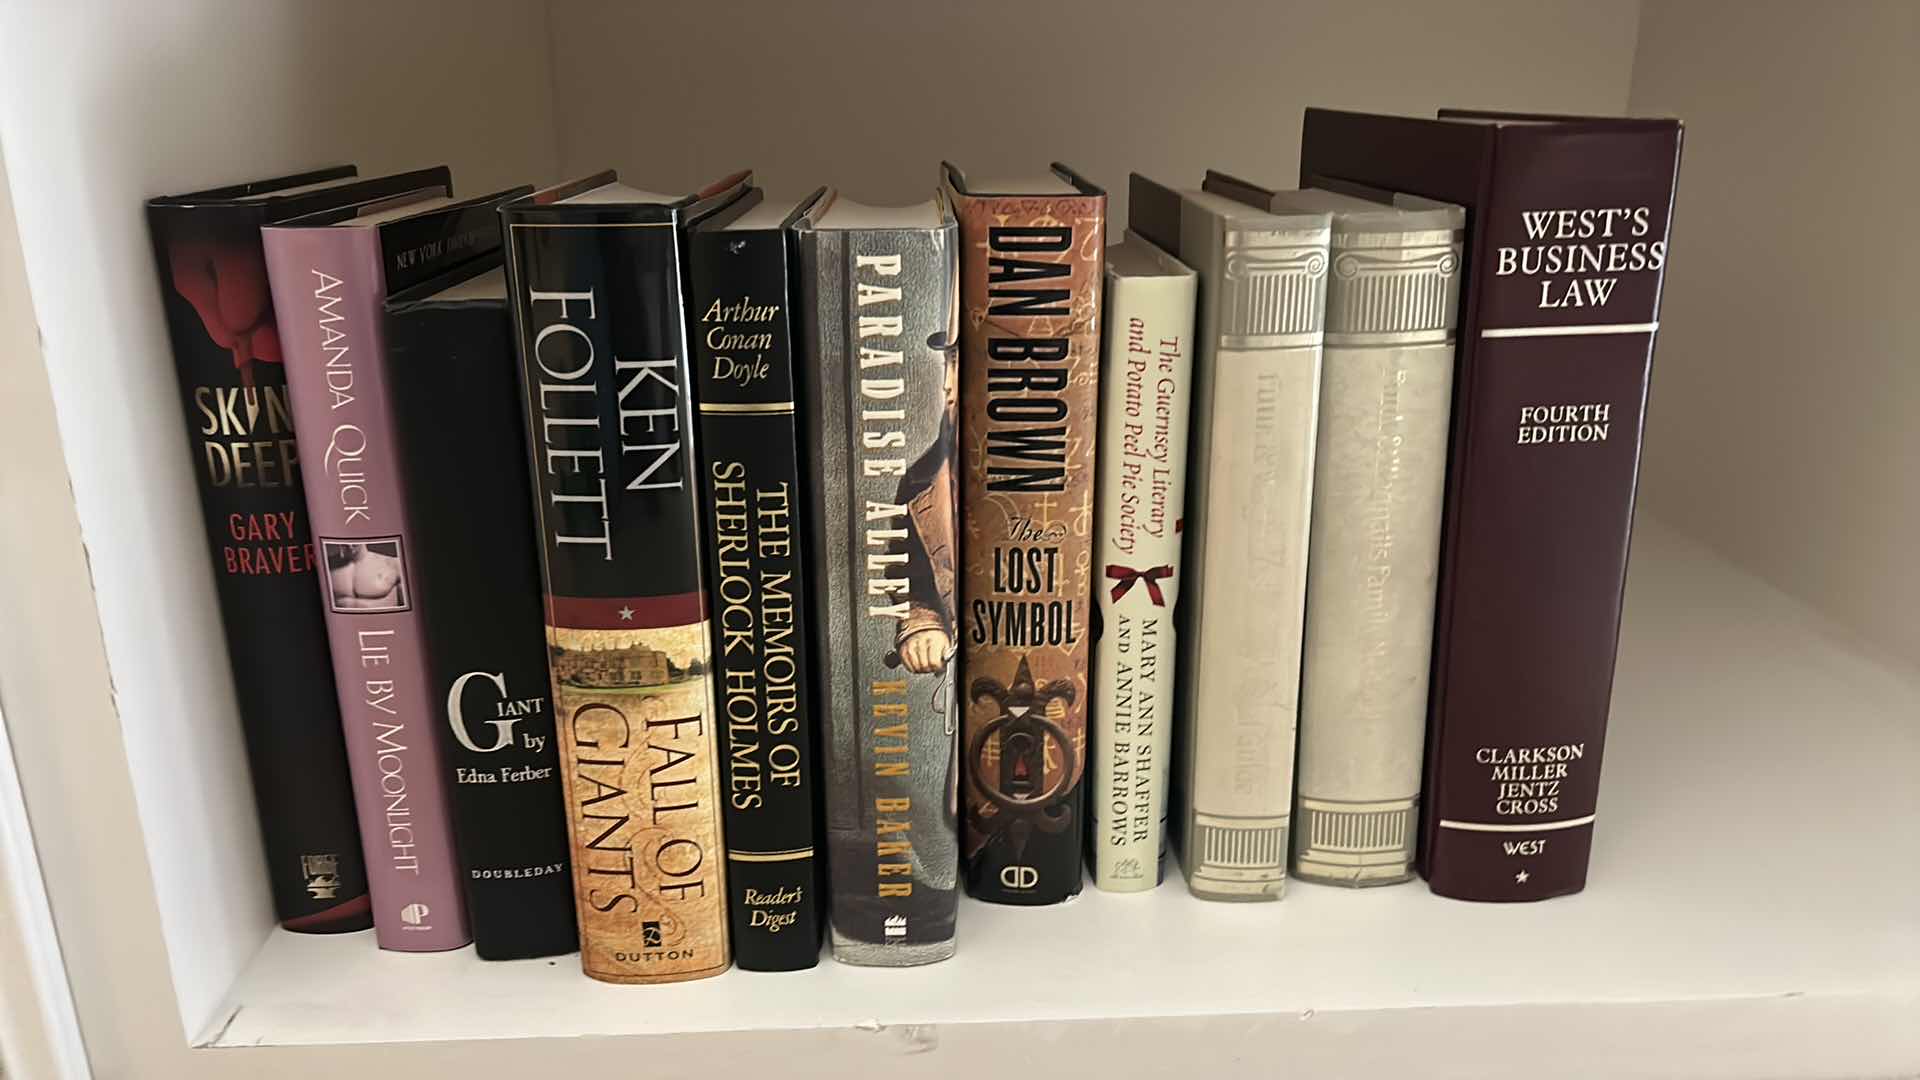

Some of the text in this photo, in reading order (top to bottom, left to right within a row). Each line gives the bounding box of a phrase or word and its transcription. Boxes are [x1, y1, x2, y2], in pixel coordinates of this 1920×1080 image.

[1520, 207, 1649, 240] WEST'S
[1496, 241, 1664, 276] BUSINESS
[702, 297, 779, 323] Arthur
[1539, 278, 1617, 308] LAW
[706, 326, 772, 350] Conan
[712, 355, 769, 387] Doyle
[987, 226, 1072, 493] DAN BROWN
[195, 386, 291, 436] SKIN
[312, 269, 370, 525] AMANDA QUICK
[530, 287, 612, 560] FOLLETT
[615, 355, 684, 491] KEN
[1520, 404, 1609, 425] FOURTH
[857, 254, 910, 619] PARADISE ALLEY
[1112, 318, 1151, 555] and Potato Peel Pie Society
[1141, 336, 1181, 539] The Guernsey Literary
[1517, 423, 1609, 444] EDITION
[230, 511, 294, 541] GARY
[1009, 514, 1062, 541] The
[993, 546, 1059, 593] LOST
[712, 461, 762, 810] SHERLOCK HOLMES
[757, 482, 800, 788] THE MEMOIRS OF
[971, 599, 1079, 647] SYMBOL
[448, 672, 544, 752] GIANT
[523, 734, 546, 752] by
[1110, 615, 1134, 848] AND ANNIE BARROWS
[1133, 618, 1158, 844] MARY ANN SHAFFER
[359, 630, 420, 875] LIE BY MOONLIGHT
[1475, 743, 1585, 764] CLARKSON
[456, 765, 553, 784] Edna Ferber
[1492, 762, 1569, 780] MILLER
[870, 681, 913, 898] KEVIN BAKER
[1496, 798, 1558, 815] CROSS
[1498, 780, 1559, 800] JENTZ
[572, 702, 638, 914] GIANTS
[643, 715, 705, 901] FALL OF
[1502, 840, 1546, 856] WEST
[471, 864, 564, 879] DOUBLEDAY
[744, 886, 803, 905] Reader's
[750, 909, 798, 932] Digest
[615, 949, 695, 962] DUTTON
